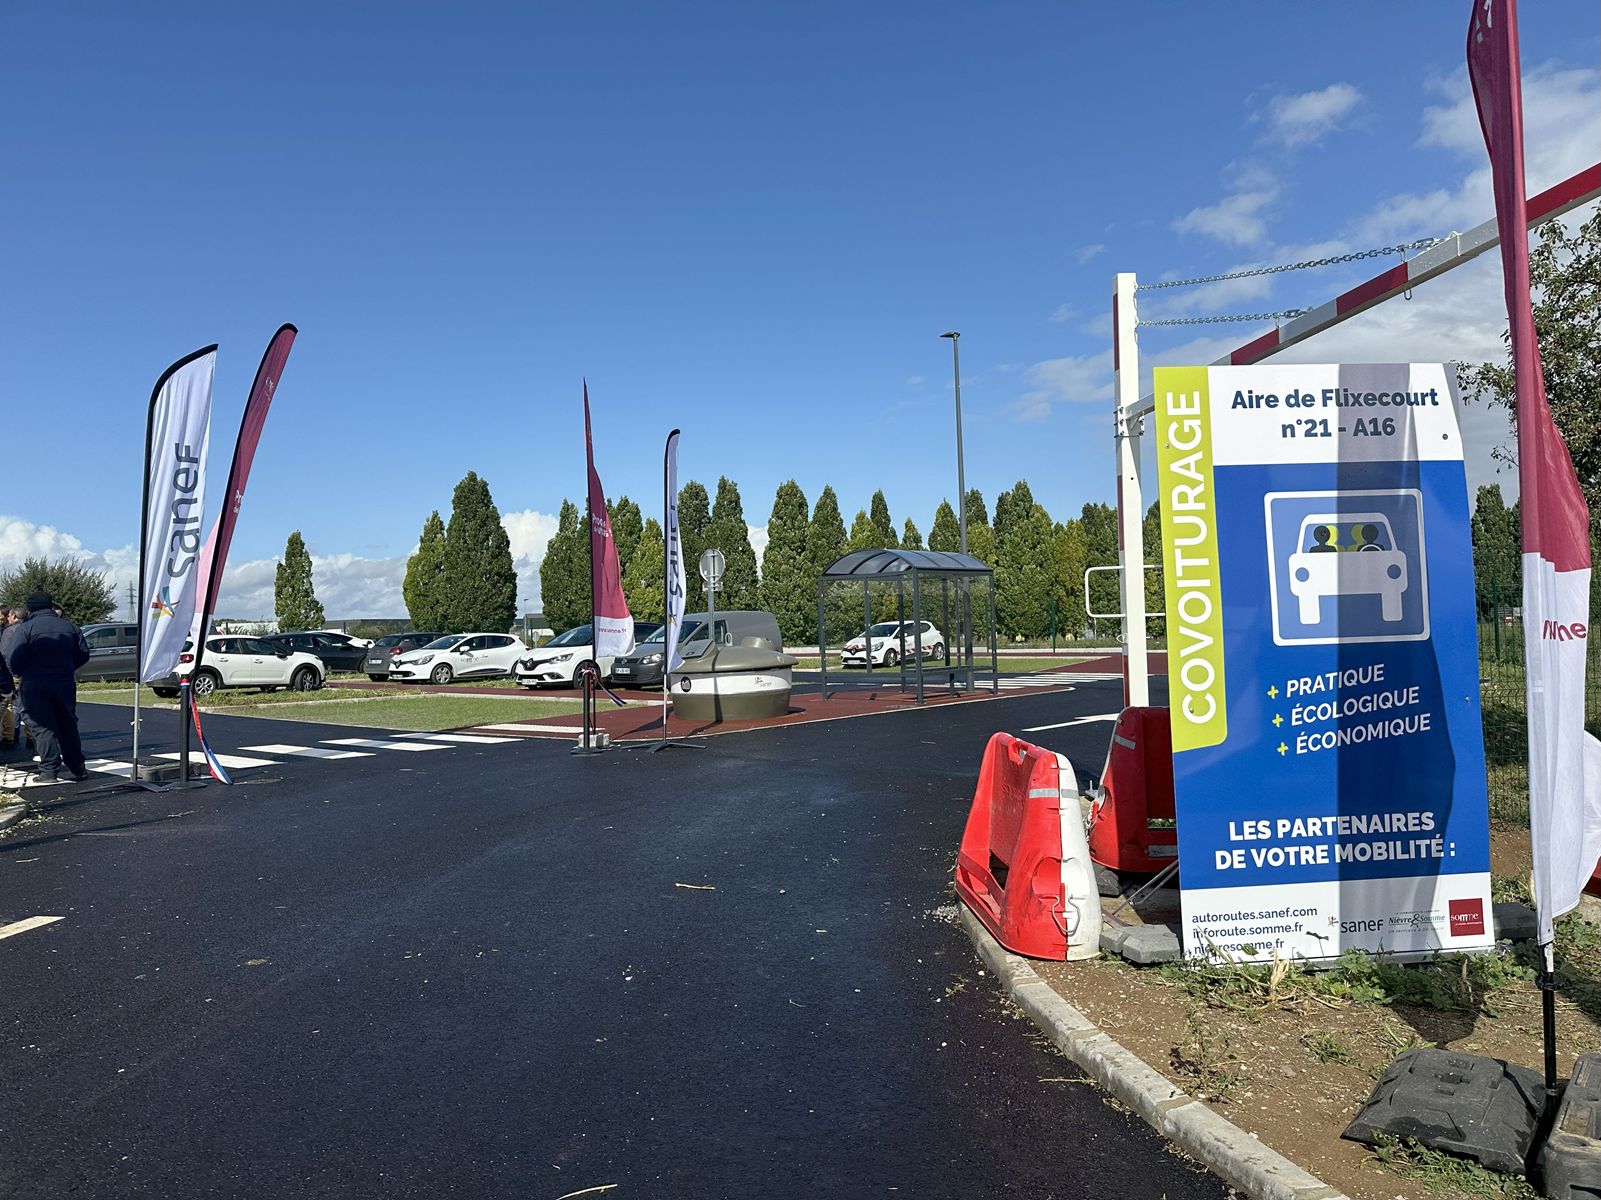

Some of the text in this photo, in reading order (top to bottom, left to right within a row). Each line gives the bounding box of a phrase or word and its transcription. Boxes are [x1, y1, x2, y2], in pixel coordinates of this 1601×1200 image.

[1231, 388, 1439, 409] Aire de Flixecourt
[1281, 418, 1332, 438] n°21
[1352, 417, 1396, 437] A16
[1166, 390, 1217, 724] COVOITURAGE
[1286, 663, 1385, 698] PRATIQUE
[1291, 686, 1420, 726] ÉCOLOGIQUE
[1296, 713, 1431, 754] ÉCONOMIQUE
[1229, 811, 1435, 841] LES PARTENAIRES
[1215, 849, 1246, 870] DE
[1249, 845, 1329, 868] VOTRE
[1335, 833, 1444, 863] MOBILITÉ
[1191, 907, 1318, 923] autoroutes.sanef.com
[1340, 919, 1384, 933] sanef
[1388, 915, 1412, 925] Nièvre
[1420, 914, 1446, 923] Somme
[1450, 912, 1479, 922] somme
